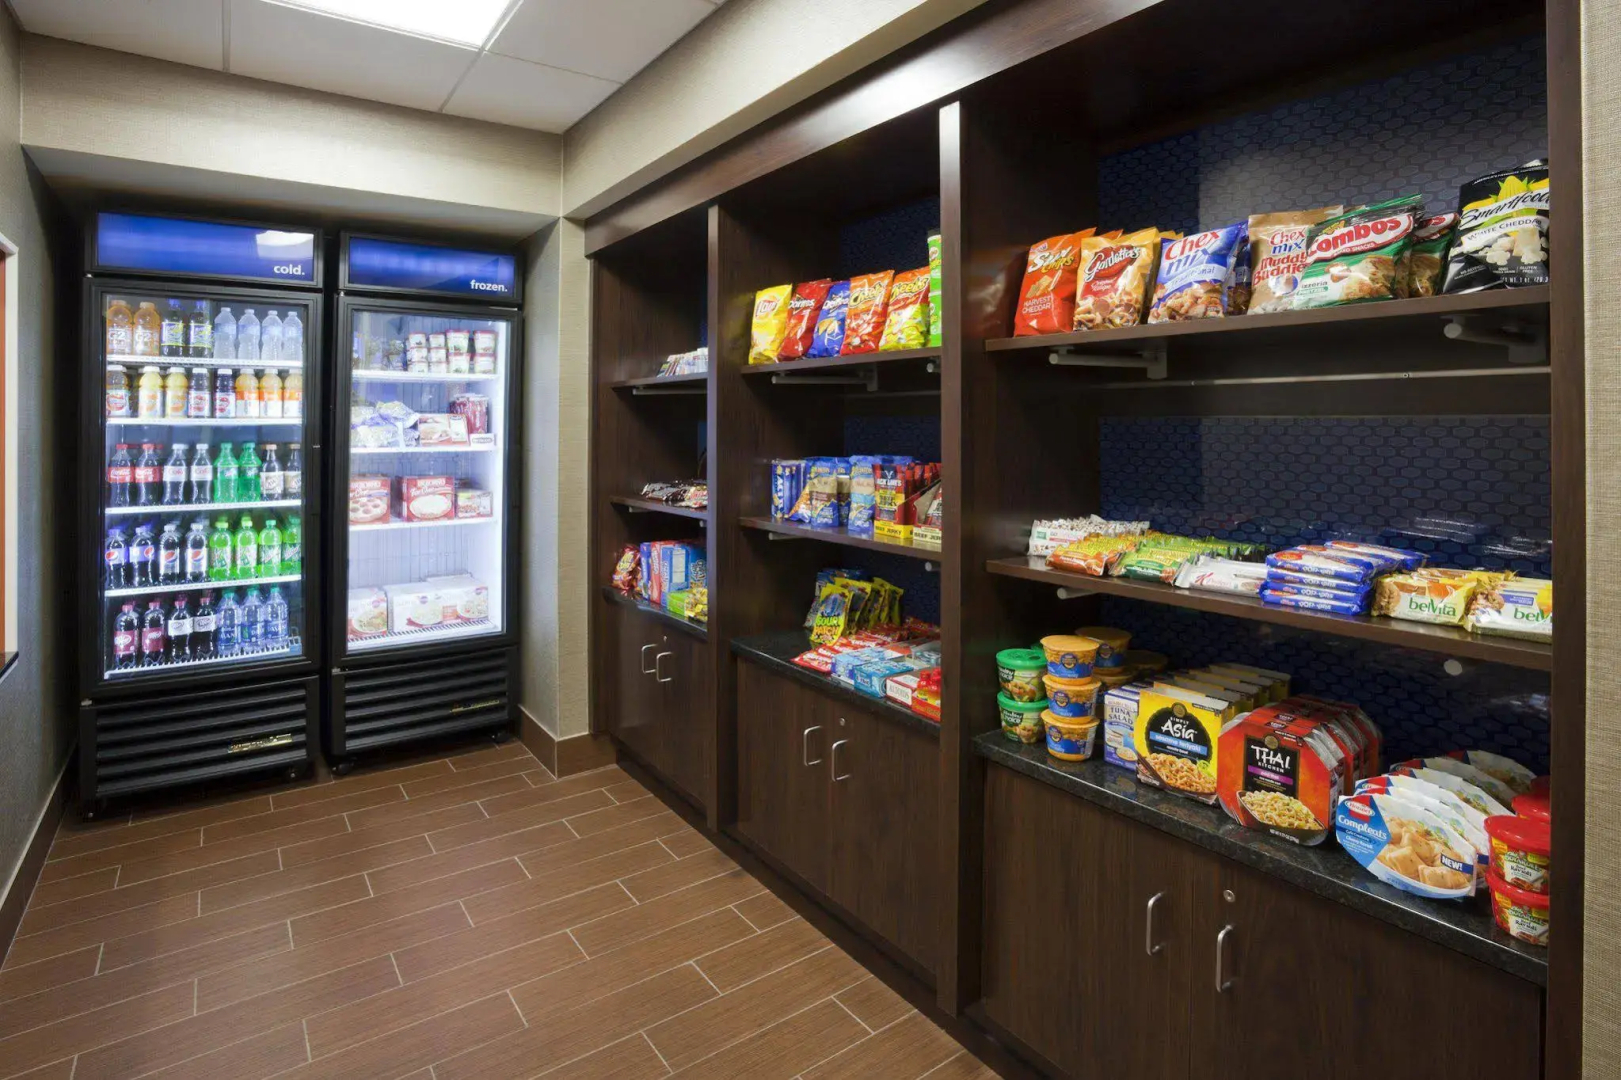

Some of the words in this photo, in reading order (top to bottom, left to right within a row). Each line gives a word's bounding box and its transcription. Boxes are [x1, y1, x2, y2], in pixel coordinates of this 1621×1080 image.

[1270, 227, 1307, 246] Chex
[1164, 229, 1223, 261] Chex
[1272, 238, 1305, 254] mix
[1352, 242, 1375, 252] SNACKS
[1027, 245, 1073, 273] Sun
[1084, 246, 1140, 282] Gardetto's
[1166, 248, 1210, 276] mix
[1261, 252, 1308, 271] Muddy
[273, 263, 305, 276] cold.
[470, 279, 508, 292] frozen.
[1022, 302, 1051, 313] CHEDDAR
[1023, 295, 1051, 307] HARVEST
[1408, 597, 1457, 617] belVita
[816, 616, 839, 625] SOUR
[815, 626, 838, 635] PATCH
[1111, 707, 1131, 717] TUNA
[1108, 714, 1134, 725] SALAD
[1161, 718, 1195, 742] Asia
[1179, 740, 1201, 752] teriyaki
[1251, 745, 1291, 769] THAI
[1258, 762, 1285, 774] KITCHEN
[1338, 815, 1387, 840] Compleats
[1441, 855, 1463, 871] NEW!
[1510, 866, 1532, 877] Ravioli
[1516, 920, 1538, 931] Ravioli
